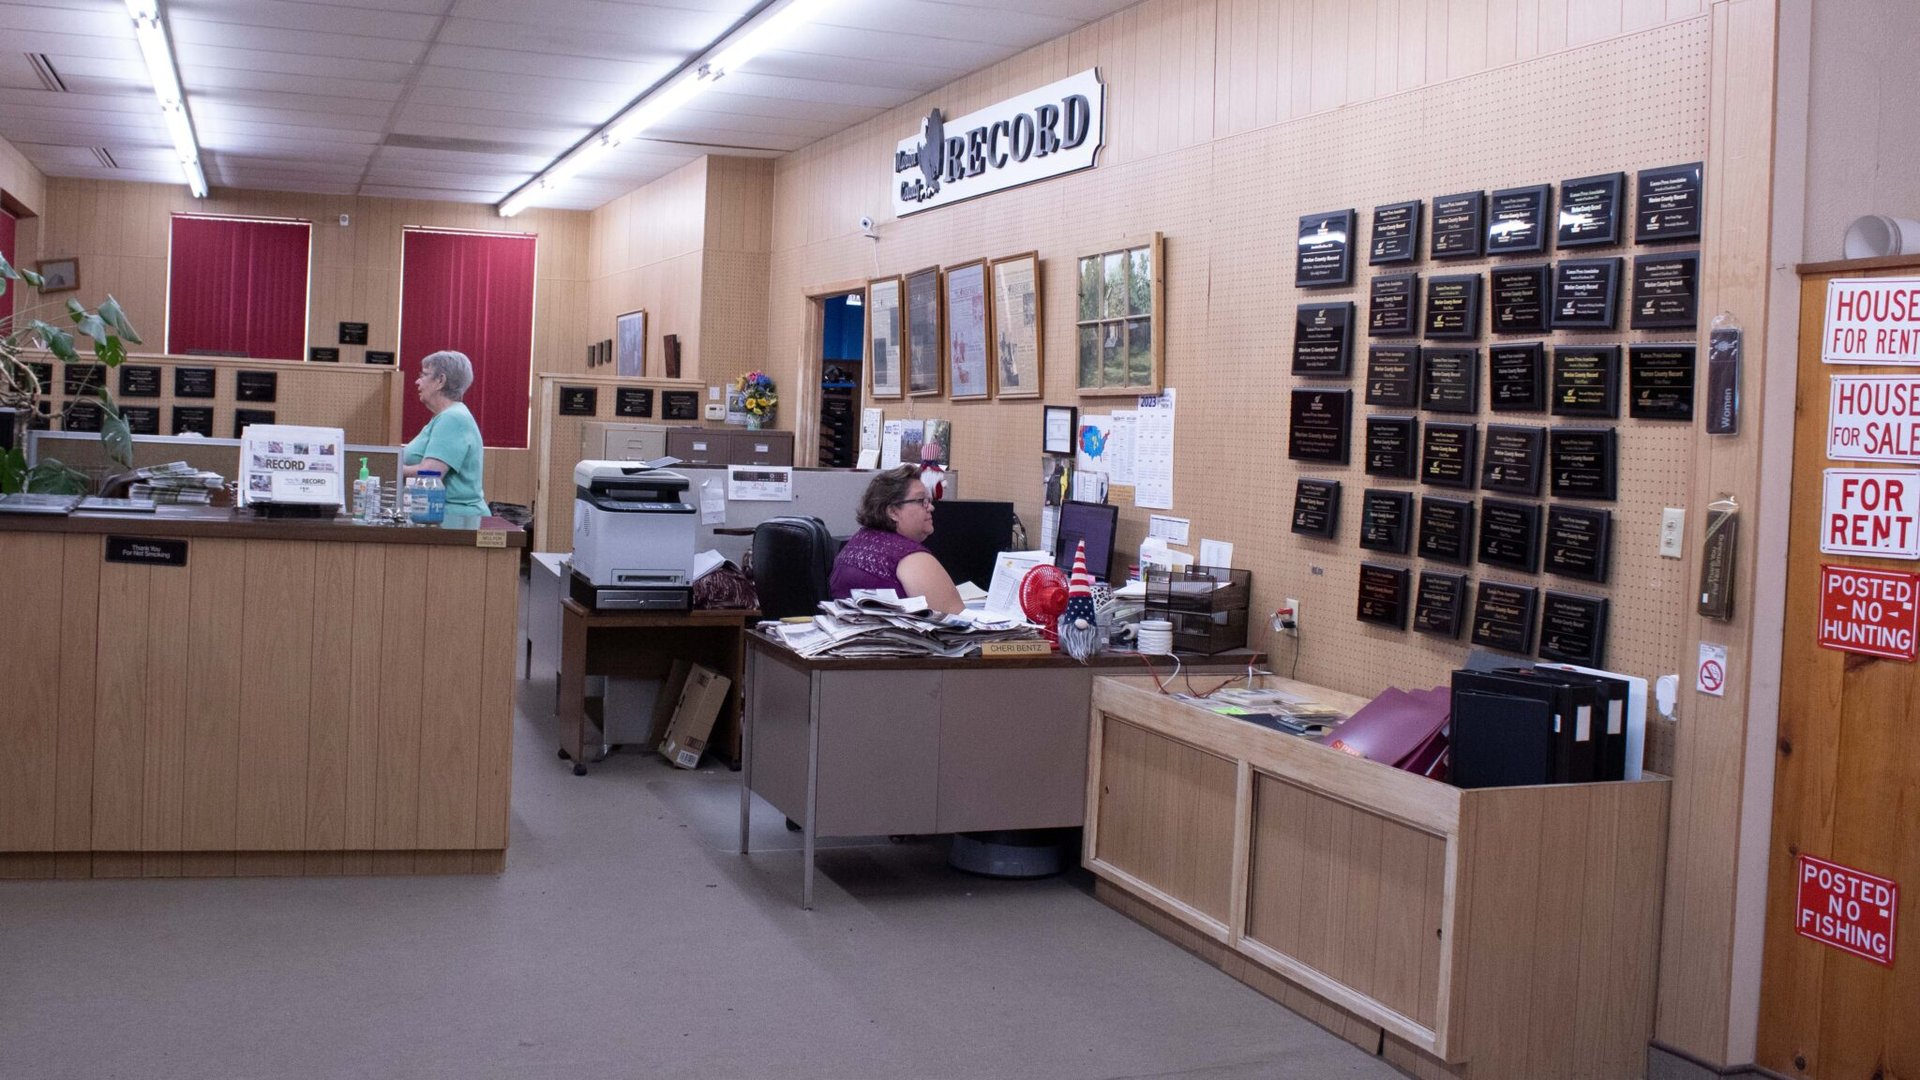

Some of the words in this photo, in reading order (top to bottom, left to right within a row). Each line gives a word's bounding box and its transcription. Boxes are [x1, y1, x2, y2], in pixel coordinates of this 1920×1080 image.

[944, 94, 1090, 182] RECORD
[1837, 290, 1920, 322] HOUSE
[1834, 328, 1867, 354] FOR
[1876, 328, 1920, 355] RENT
[1140, 396, 1157, 407] 2023
[1721, 388, 1732, 428] Women
[1839, 383, 1920, 417] HOUSE
[1834, 427, 1860, 446] FOR
[1864, 422, 1920, 455] SALE
[266, 459, 305, 470] RECORD
[1841, 478, 1904, 512] FOR
[1830, 514, 1912, 548] RENT
[145, 551, 170, 559] Smoking
[1828, 574, 1911, 602] POSTED
[1852, 600, 1882, 622] NO
[1824, 619, 1911, 650] HUNTING
[1804, 864, 1890, 906] POSTED
[1829, 895, 1860, 921] NO
[1802, 909, 1886, 954] FISHING
